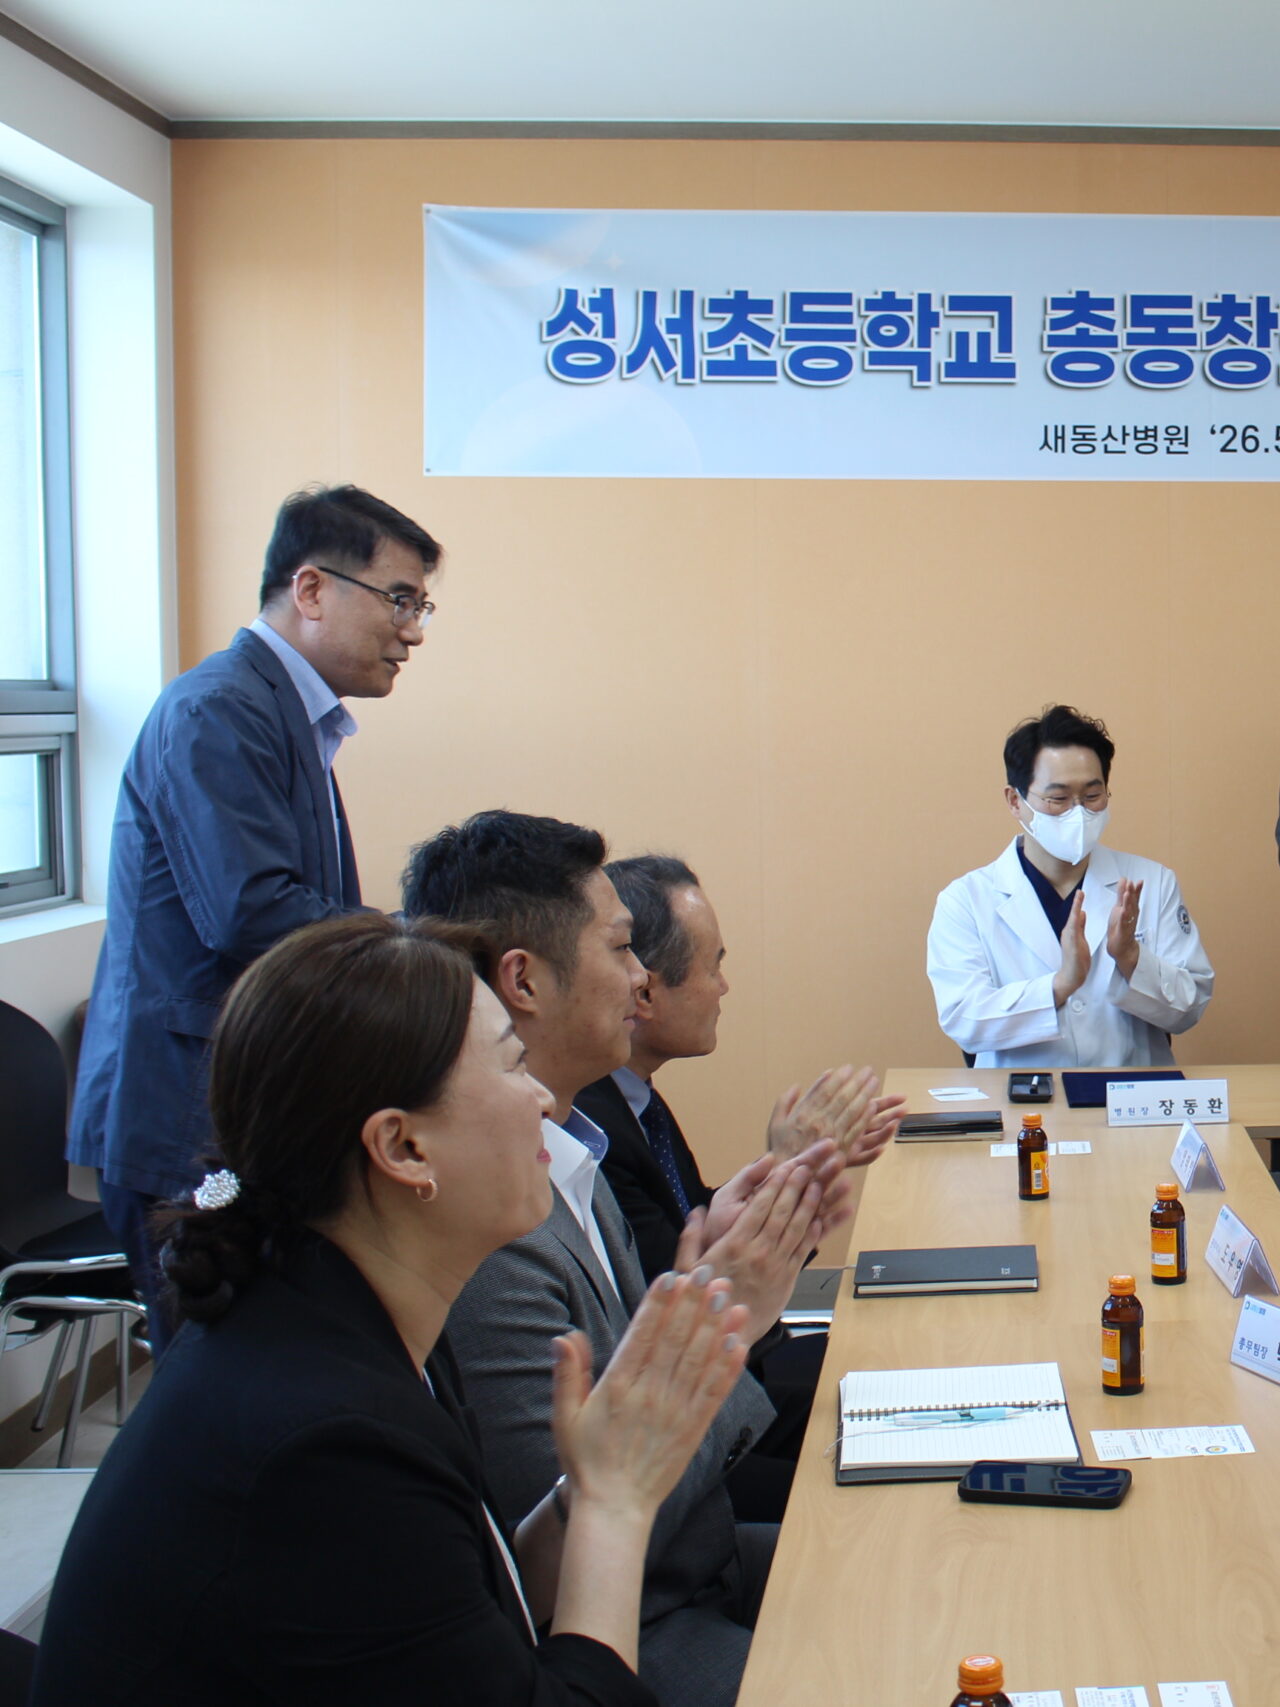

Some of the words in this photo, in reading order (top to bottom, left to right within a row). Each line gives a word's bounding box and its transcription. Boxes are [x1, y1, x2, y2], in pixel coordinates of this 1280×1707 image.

[543, 287, 1018, 386] 성서초등학교
[1040, 423, 1190, 457] 새동산병원
[1238, 1337, 1269, 1360] 총무팀장
